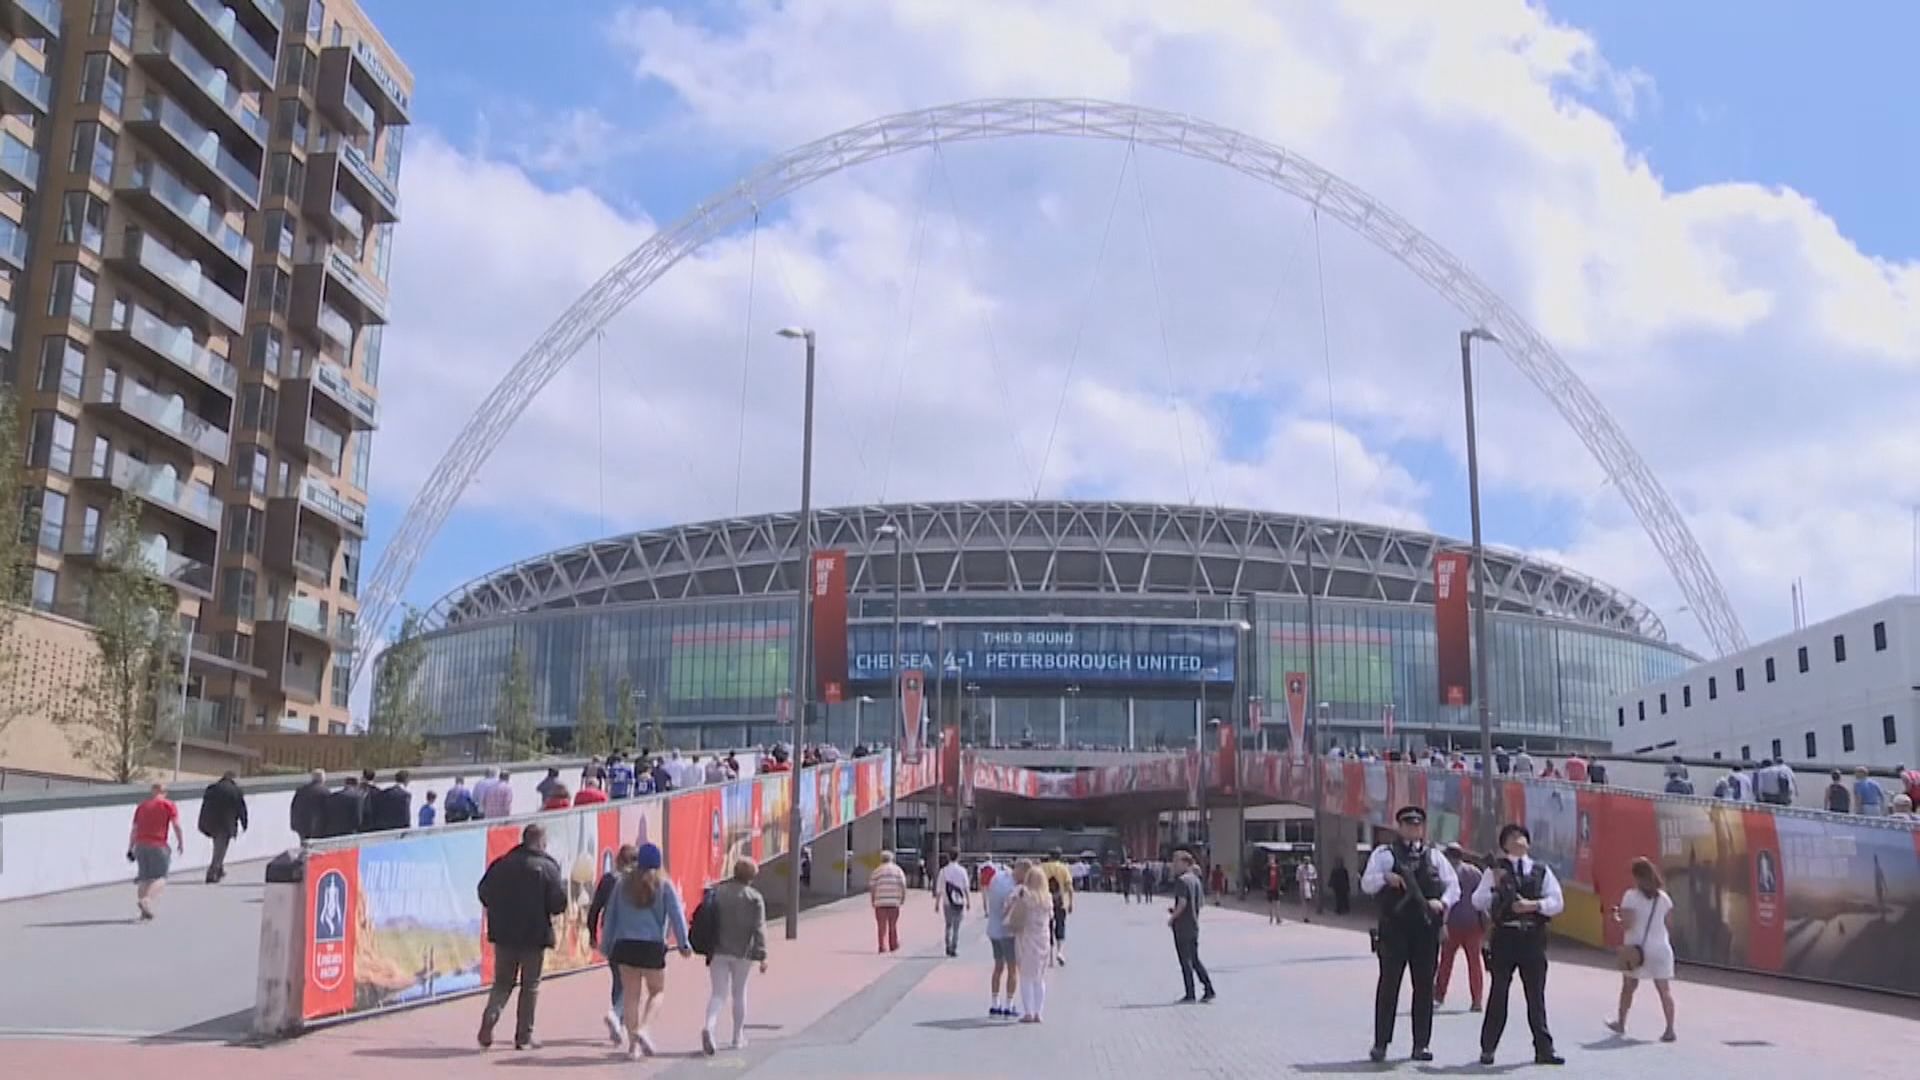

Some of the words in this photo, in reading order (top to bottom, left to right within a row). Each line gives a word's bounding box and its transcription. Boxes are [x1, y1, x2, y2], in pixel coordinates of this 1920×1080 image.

[983, 632, 1022, 644] THIRD
[1026, 632, 1073, 645] ROUND
[856, 653, 934, 669] CHELSEA
[943, 650, 973, 668] 4-1
[986, 653, 1131, 671] PETERBOROUGH
[1137, 655, 1202, 672] UNITED
